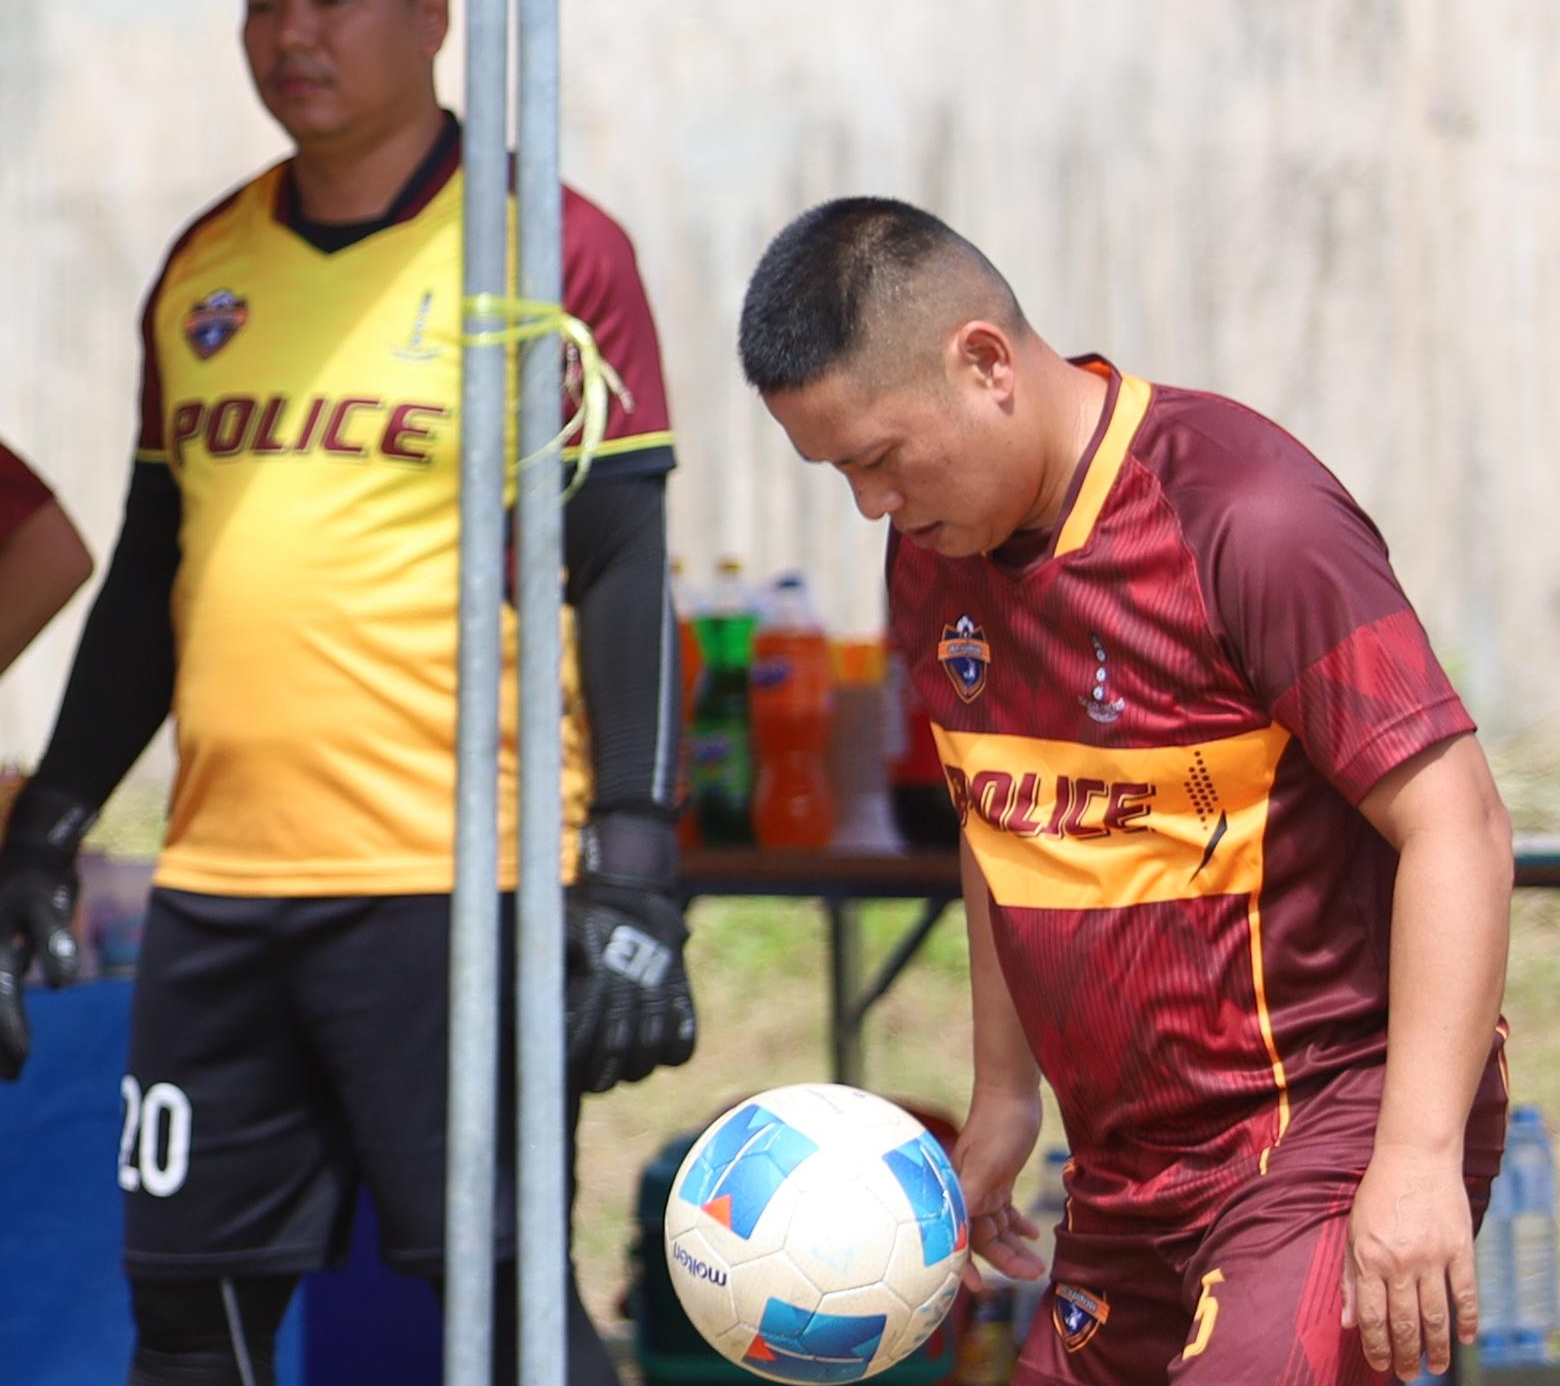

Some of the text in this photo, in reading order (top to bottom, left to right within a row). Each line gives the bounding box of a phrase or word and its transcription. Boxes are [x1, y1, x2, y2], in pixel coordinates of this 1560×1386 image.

[174, 391, 451, 471] POLICE
[944, 764, 1157, 840] POLICE
[118, 1074, 192, 1197] 20
[672, 1241, 728, 1288] molten
